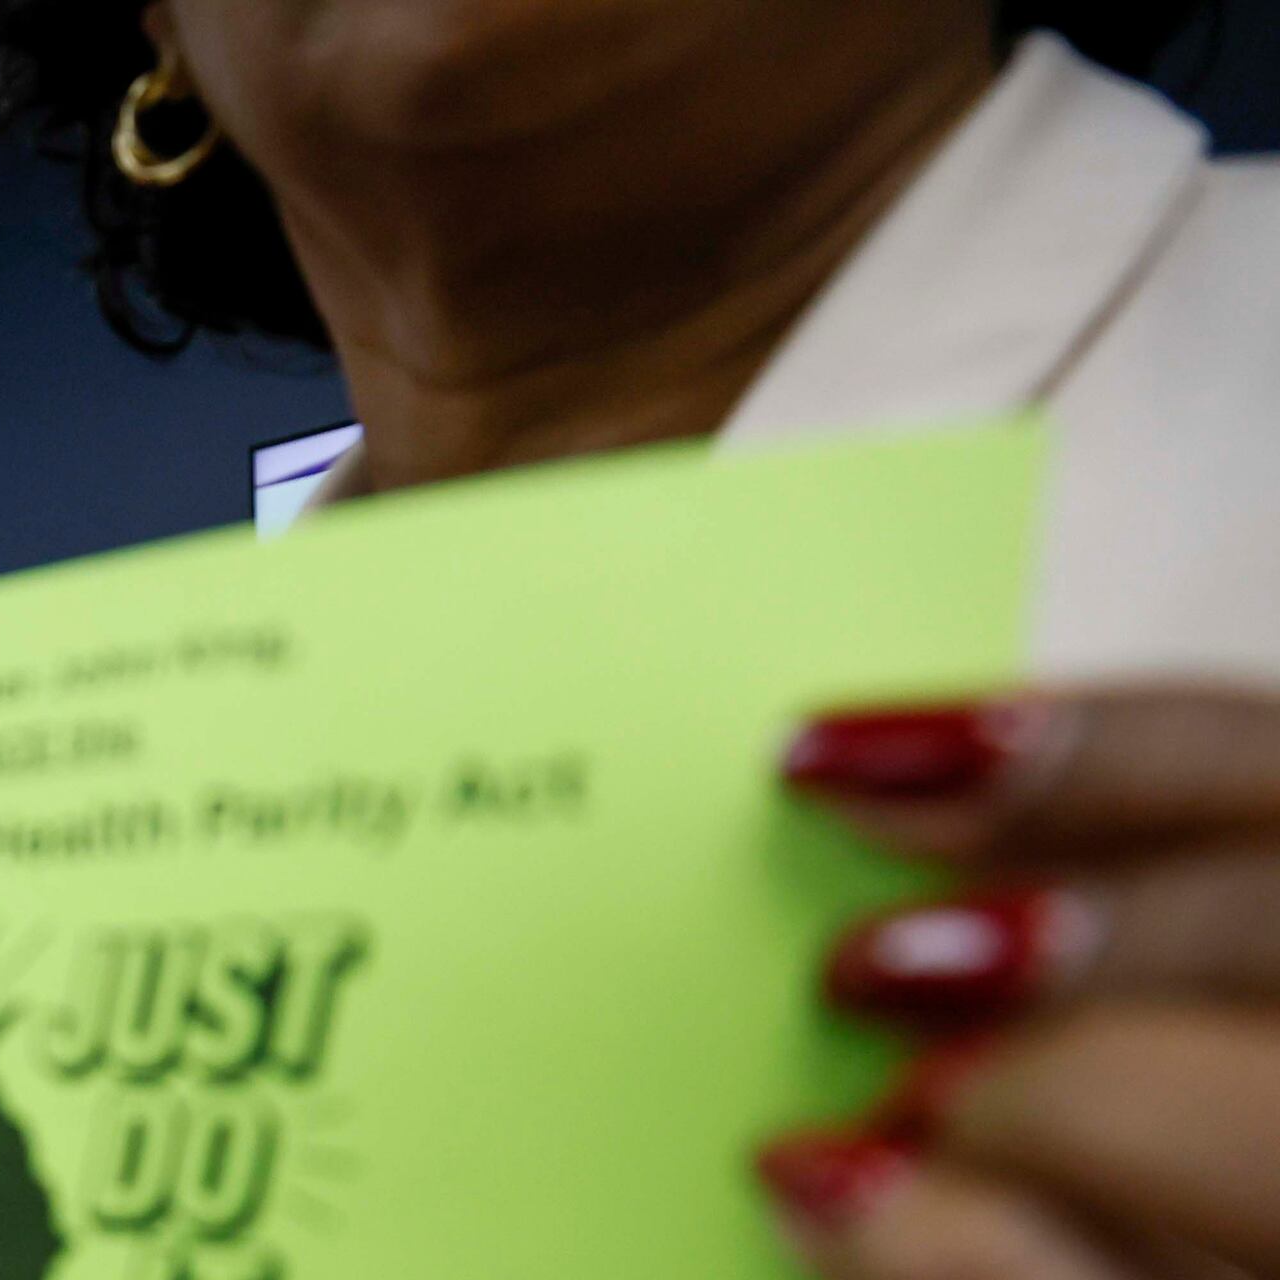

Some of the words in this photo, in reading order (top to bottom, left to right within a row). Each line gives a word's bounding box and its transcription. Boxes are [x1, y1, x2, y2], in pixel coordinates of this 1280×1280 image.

[194, 775, 418, 858] Parity
[446, 747, 592, 820] Act
[37, 914, 374, 1088] JUST
[82, 1096, 283, 1243] DO
